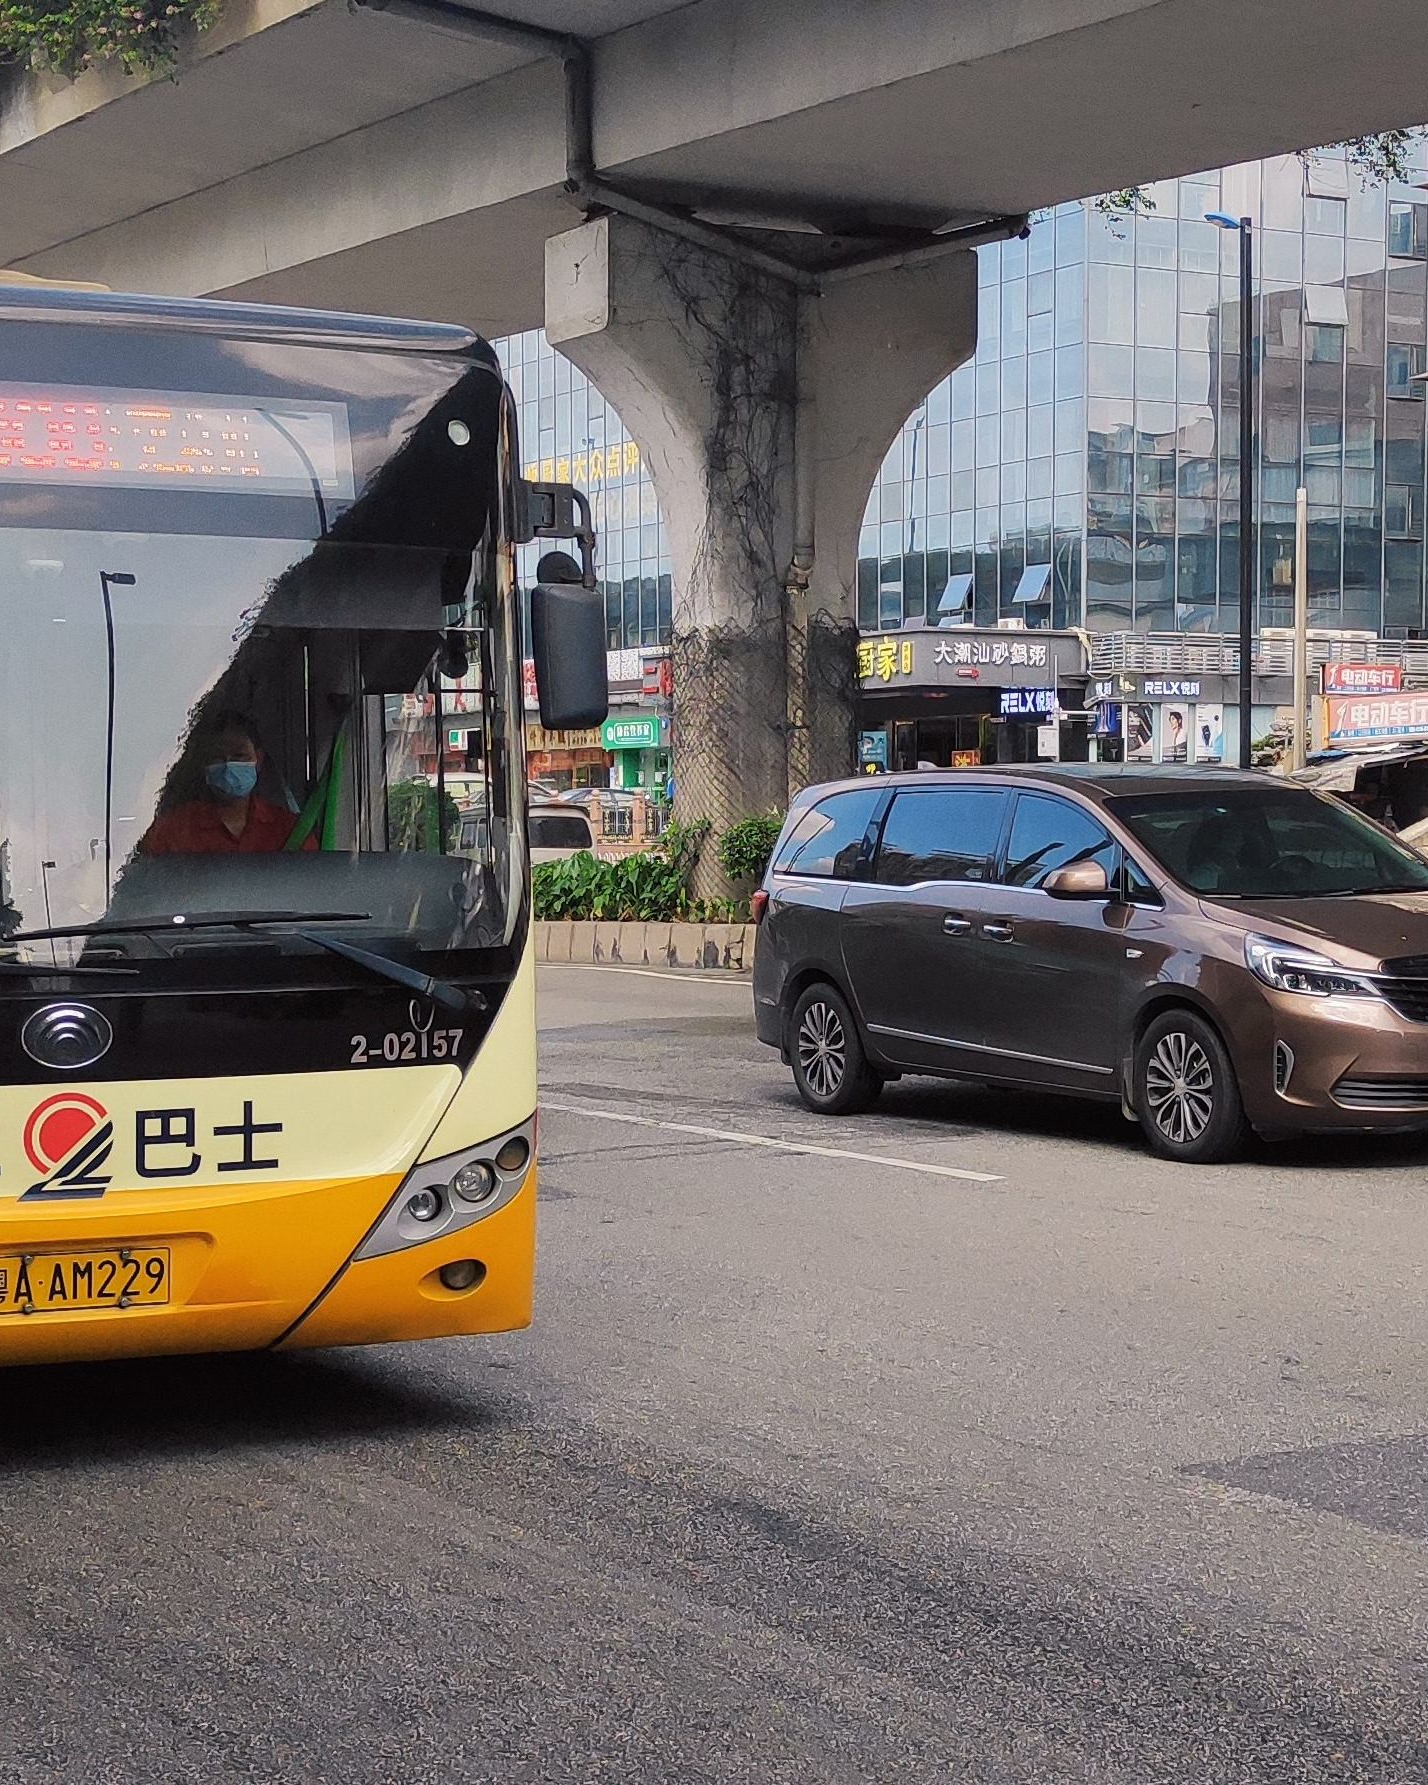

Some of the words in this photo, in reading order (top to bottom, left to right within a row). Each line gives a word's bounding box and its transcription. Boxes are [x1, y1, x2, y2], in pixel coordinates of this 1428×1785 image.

[1144, 681, 1181, 695] RELX
[1340, 669, 1395, 687] 电动车行
[1000, 692, 1035, 714] RELX
[1350, 698, 1428, 729] 电动车行
[350, 1028, 463, 1063] 2-02157
